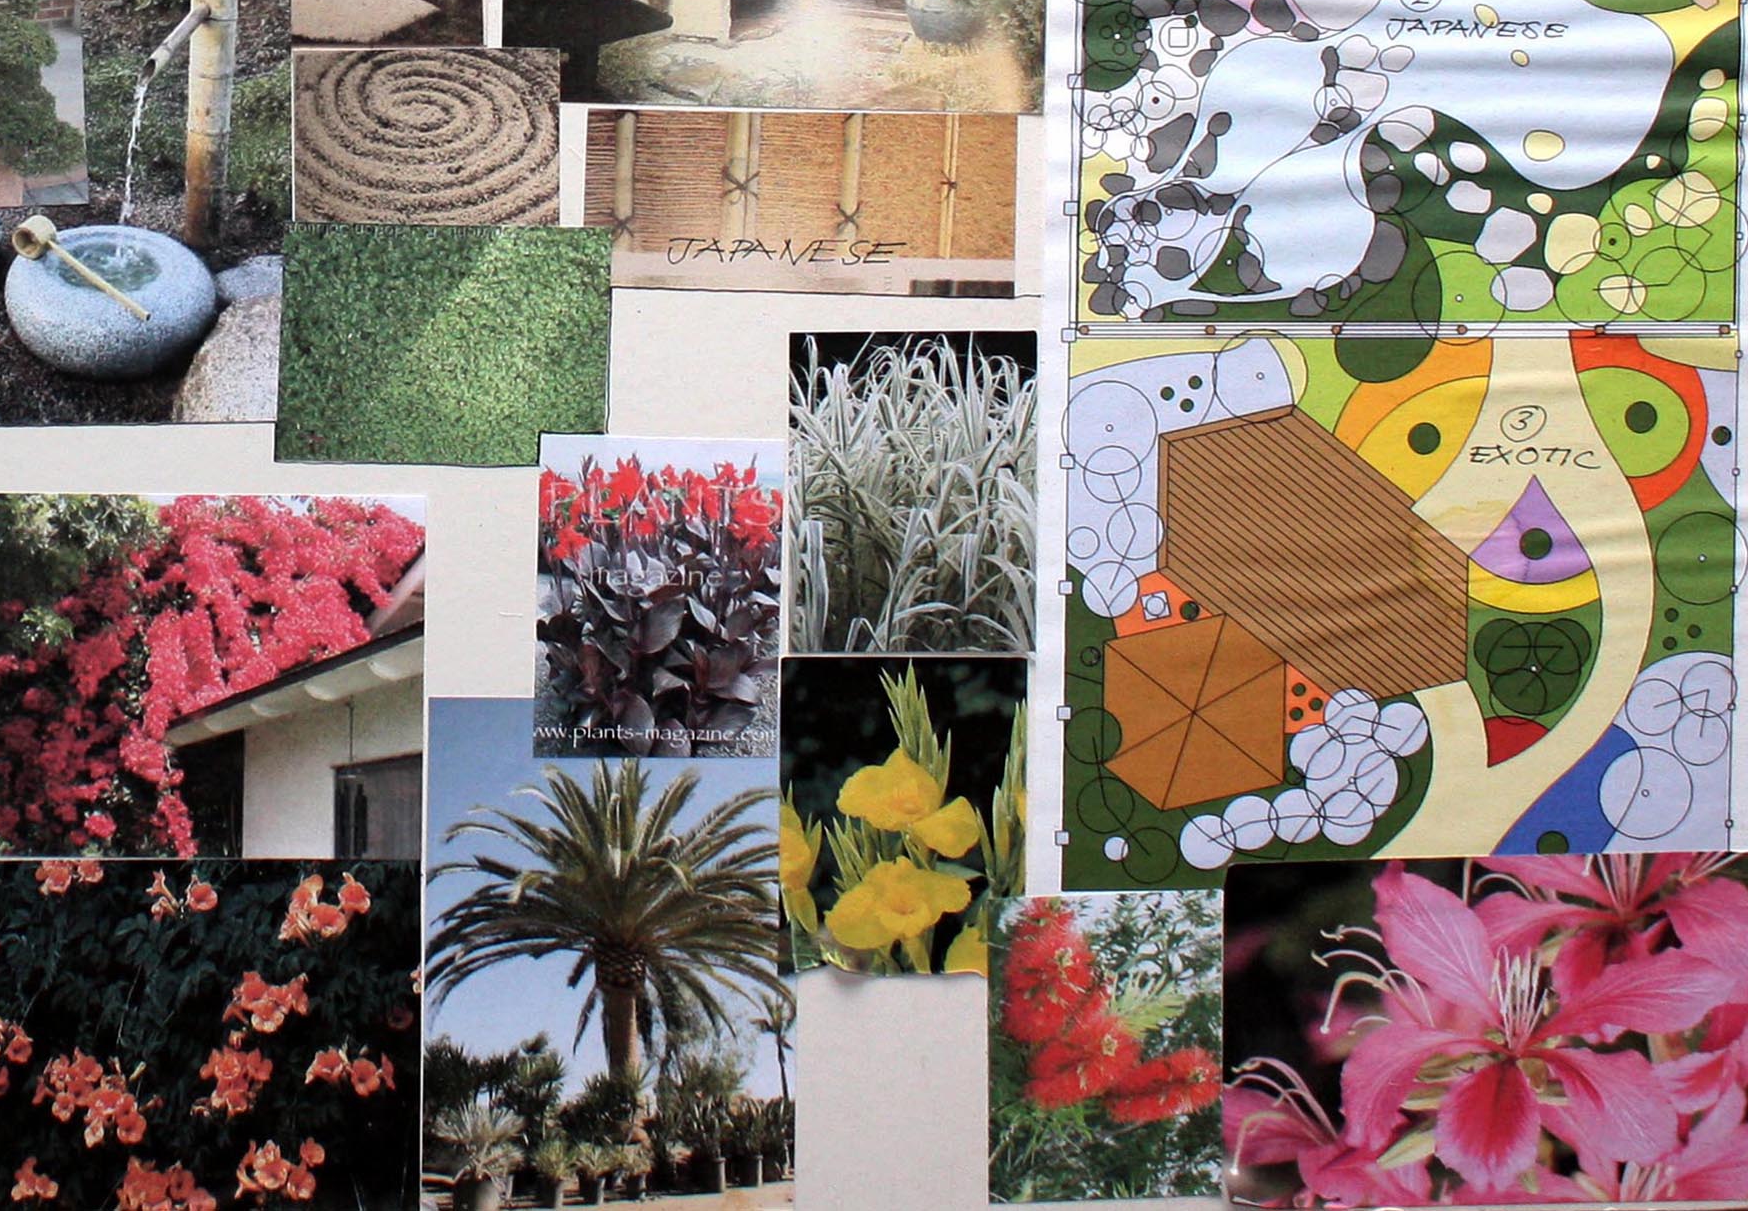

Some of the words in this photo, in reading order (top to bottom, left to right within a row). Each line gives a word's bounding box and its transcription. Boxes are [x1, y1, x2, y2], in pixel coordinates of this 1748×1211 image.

[1385, 17, 1569, 40] JAPANESE
[666, 237, 908, 267] JAPANESE
[1468, 444, 1602, 470] EXOTIC
[589, 565, 724, 599] magazine
